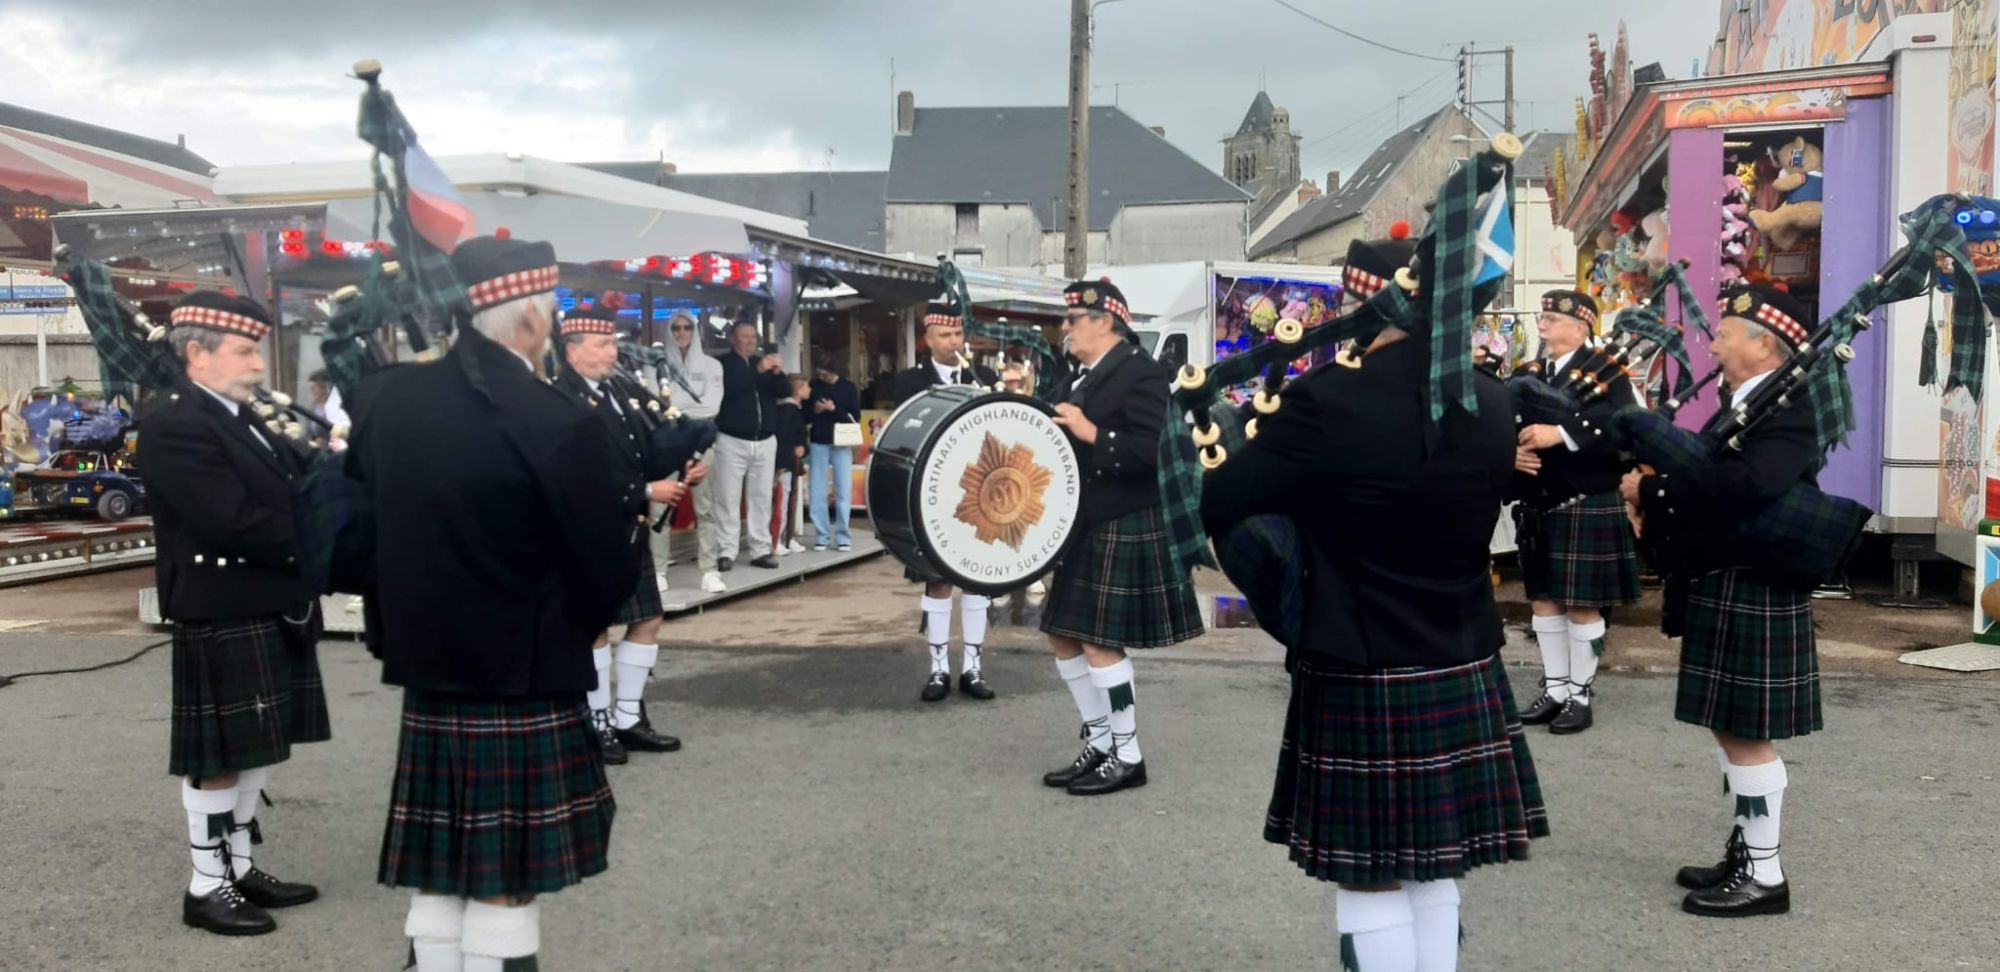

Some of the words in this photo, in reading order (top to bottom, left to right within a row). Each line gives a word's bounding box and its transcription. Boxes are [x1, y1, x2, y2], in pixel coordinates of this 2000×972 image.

[928, 434, 958, 506] GATINAIS
[959, 408, 1044, 436] HIGHLANDER
[1044, 427, 1075, 496] PIPEBAND
[959, 557, 1012, 577] MOIGNY
[1016, 553, 1040, 572] SUR
[1042, 516, 1068, 556] ECOLE
